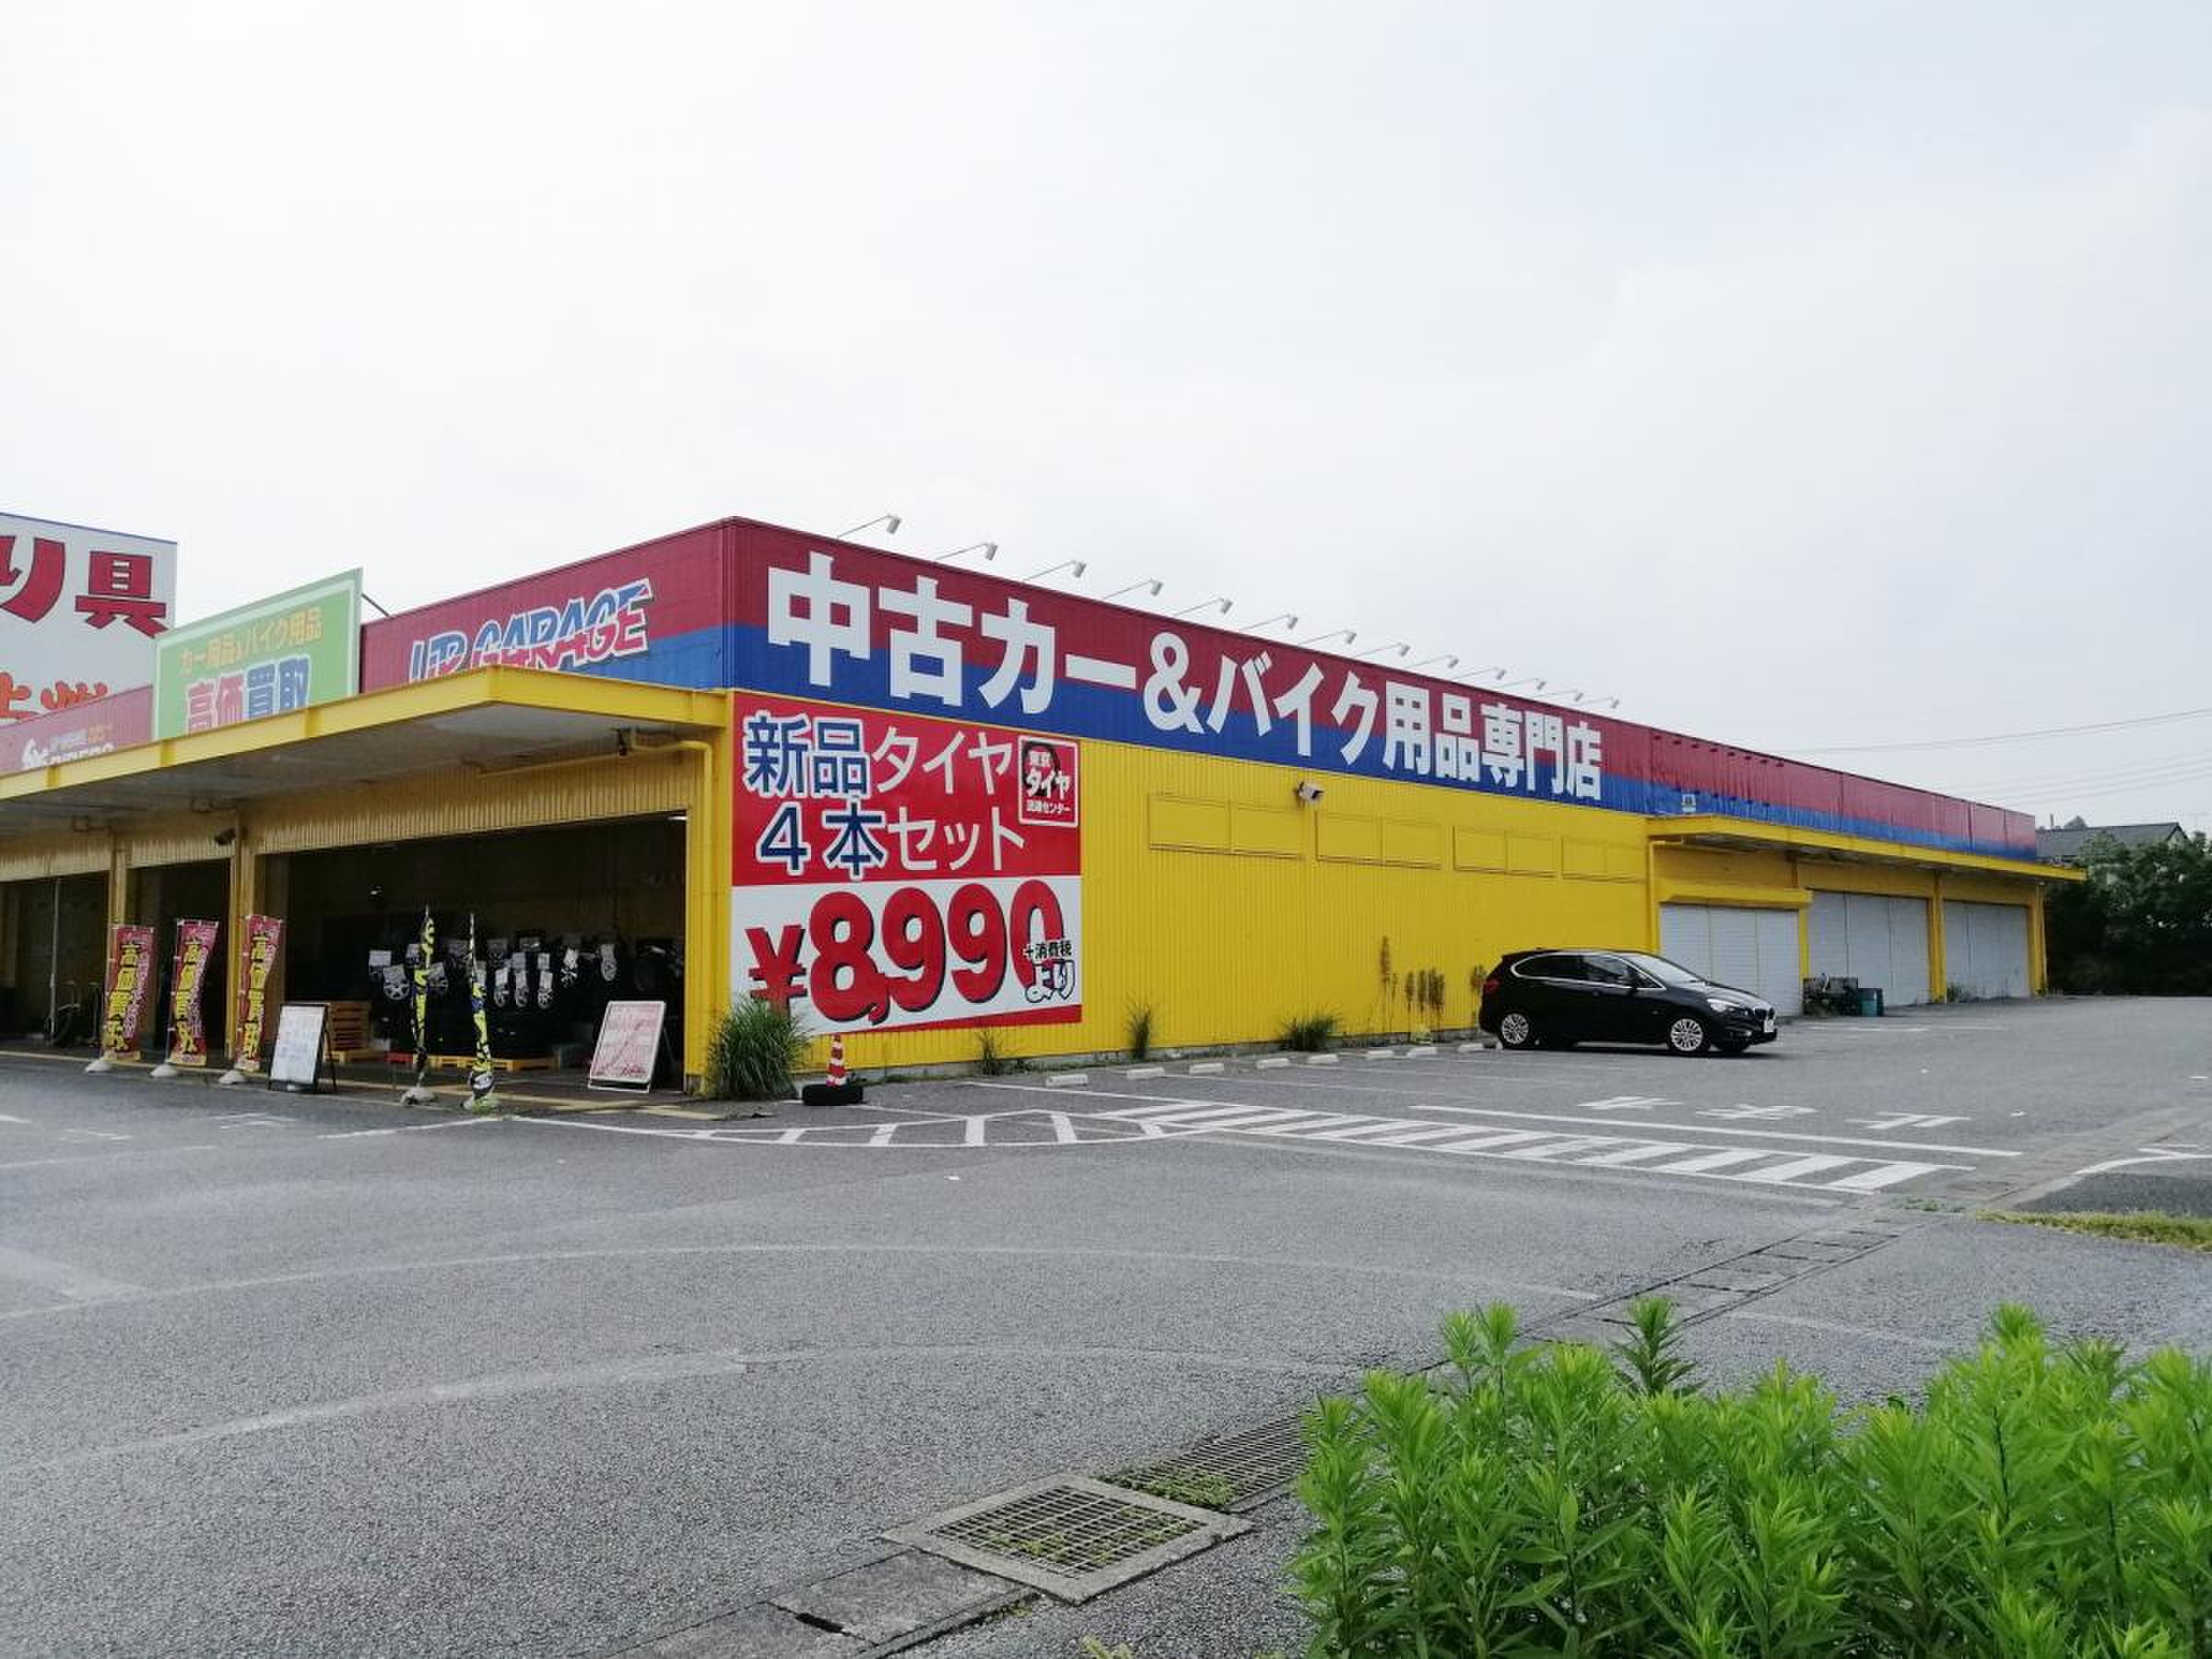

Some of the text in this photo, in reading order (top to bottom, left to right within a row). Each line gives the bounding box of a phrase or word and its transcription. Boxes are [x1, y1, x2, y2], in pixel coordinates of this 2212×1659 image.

[471, 577, 653, 672] GARAGE
[767, 551, 1602, 801] 中古カー&バイク用品専門店
[743, 710, 1013, 798] 新品タイヤ
[1026, 768, 1071, 800] タイヤ
[756, 794, 1025, 881] 4本セット
[746, 880, 1065, 1025] ¥8,990
[1025, 959, 1076, 1003] より
